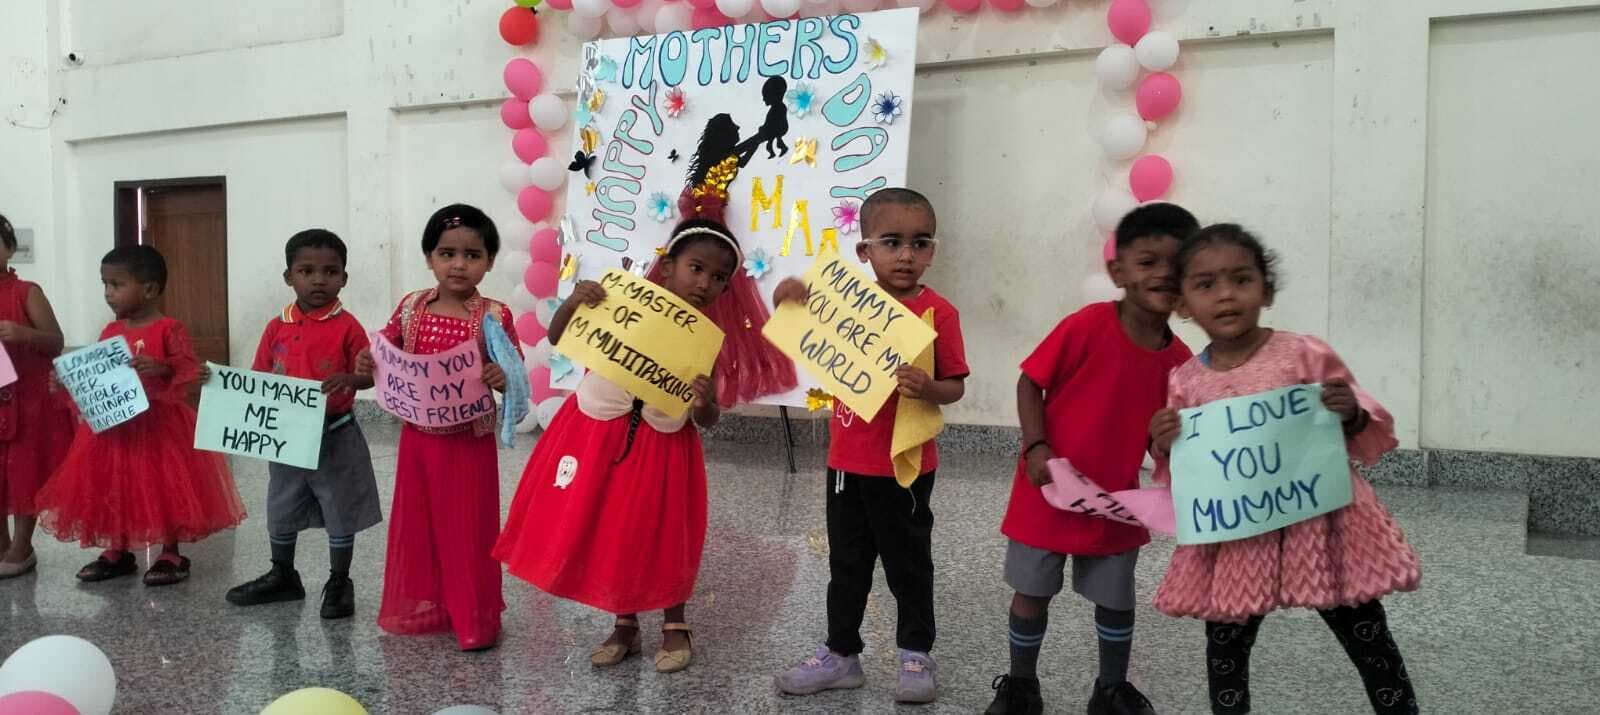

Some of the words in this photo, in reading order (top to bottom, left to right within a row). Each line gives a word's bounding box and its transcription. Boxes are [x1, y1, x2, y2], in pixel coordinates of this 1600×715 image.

[821, 72, 889, 202] DAY
[585, 79, 664, 252] HAPPY
[805, 282, 838, 324] YOU
[836, 317, 881, 356] ARE
[820, 260, 904, 332] MUMMY
[375, 338, 430, 378] MUMMY
[439, 351, 475, 376] YOU
[800, 329, 872, 395] WORLD
[219, 370, 255, 394] YOU
[262, 380, 320, 408] MAKE
[384, 391, 420, 421] BEST
[426, 393, 492, 425] FRIEND
[387, 372, 421, 402] ARE
[430, 379, 465, 401] MY
[244, 402, 279, 430] ME
[1186, 412, 1202, 440] I
[1226, 387, 1310, 434] LOVE
[222, 426, 287, 459] HAPPY
[1211, 442, 1282, 480] YOU
[1192, 473, 1322, 533] MUMMY
